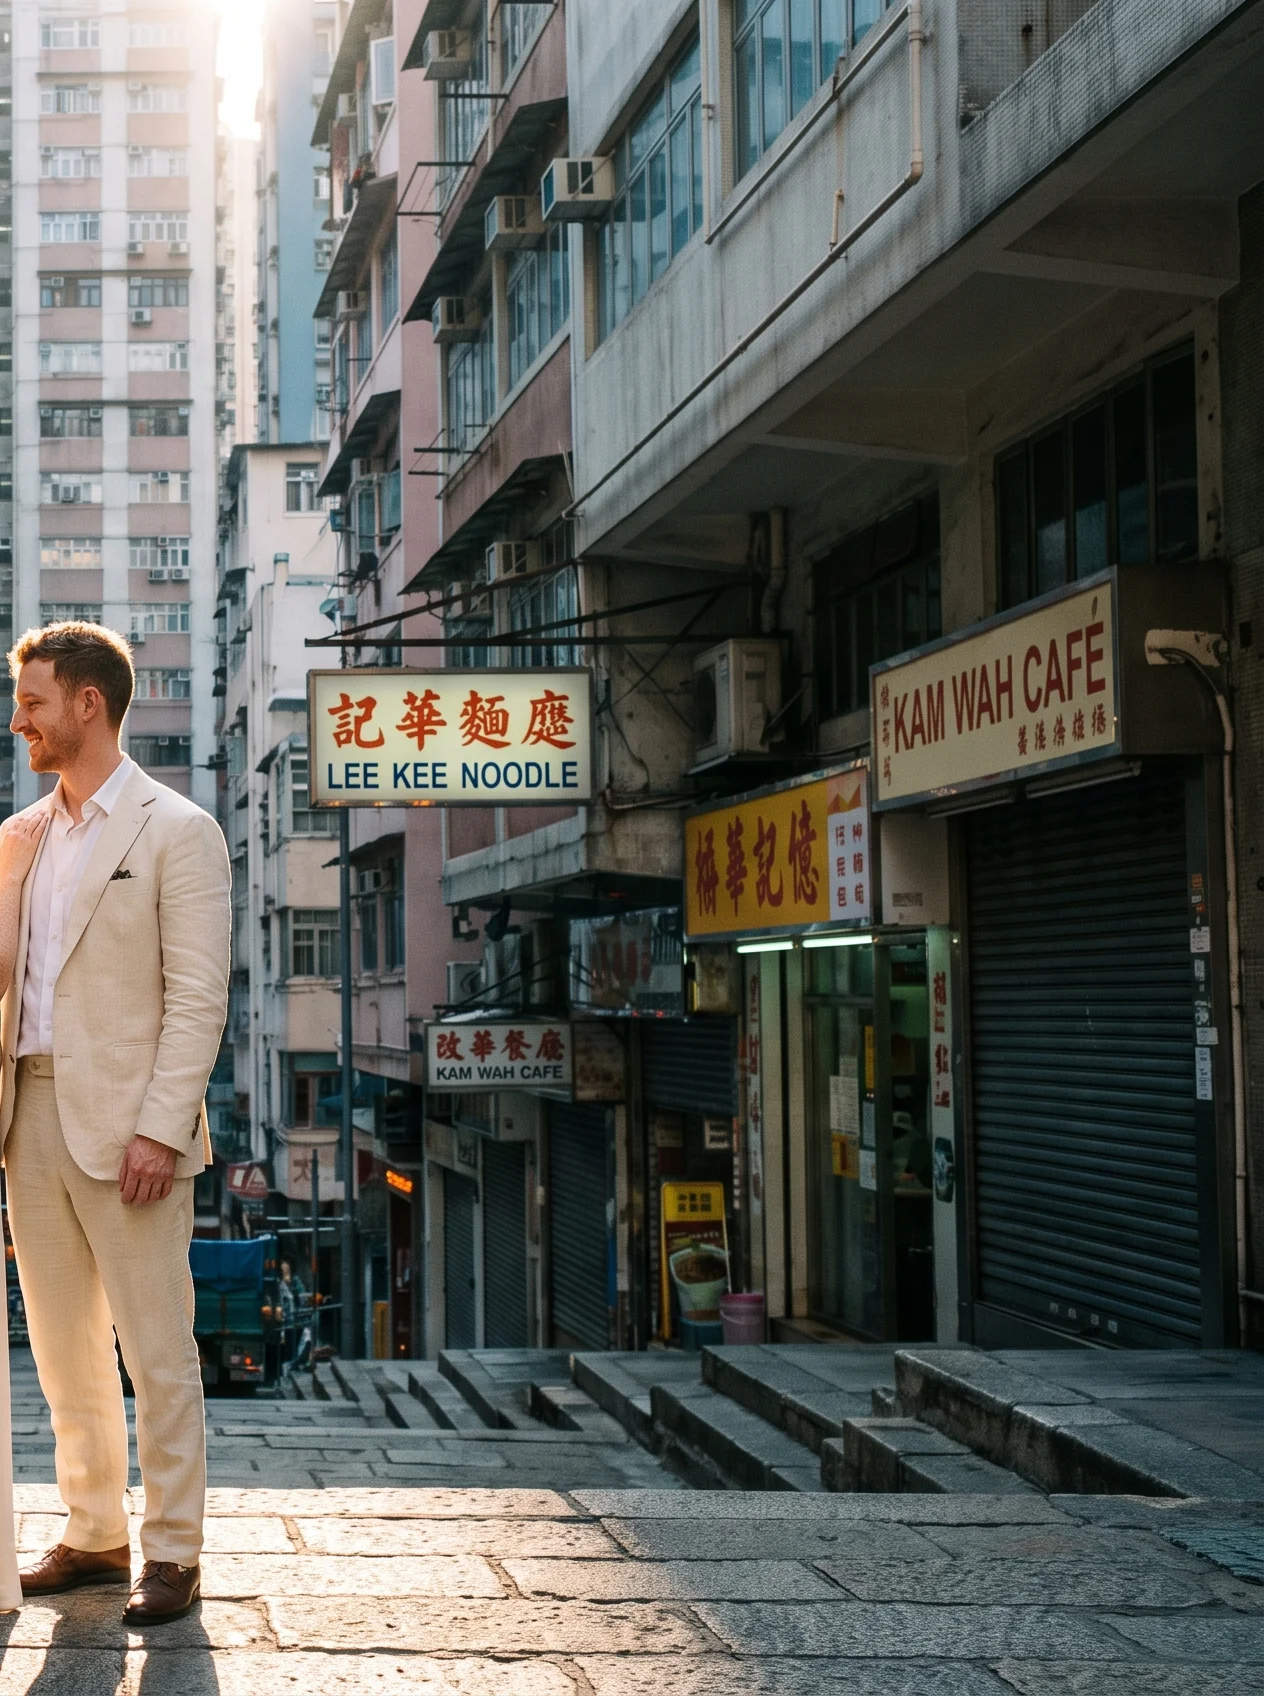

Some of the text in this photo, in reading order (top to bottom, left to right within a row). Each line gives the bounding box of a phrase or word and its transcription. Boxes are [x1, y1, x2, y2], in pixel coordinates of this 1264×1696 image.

[893, 679, 945, 754] KAM
[951, 654, 1014, 736] WAH
[327, 760, 579, 789] LEE KEE NOODLE
[436, 1065, 564, 1081] KAM WAH CAFE
